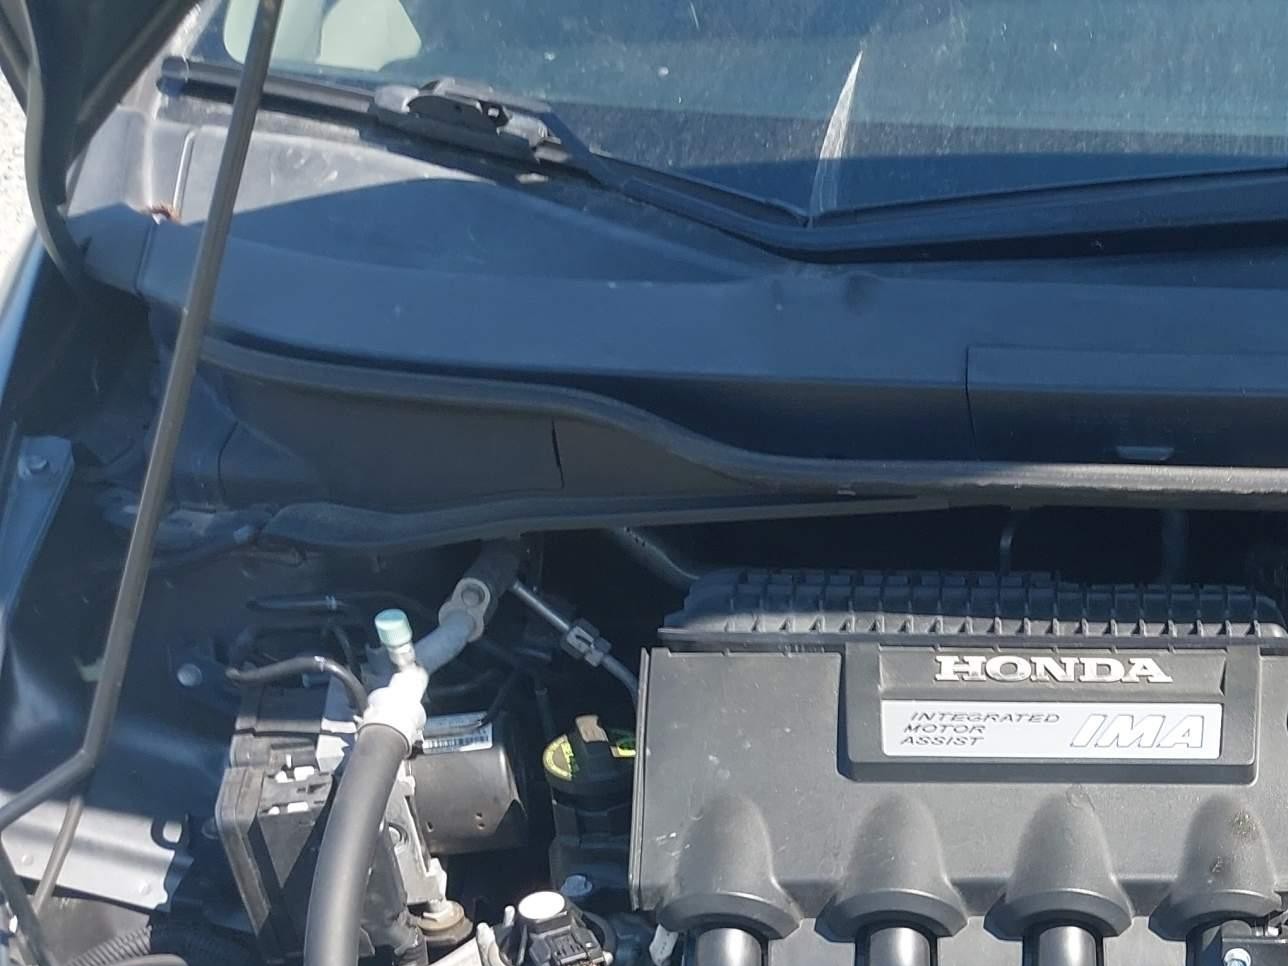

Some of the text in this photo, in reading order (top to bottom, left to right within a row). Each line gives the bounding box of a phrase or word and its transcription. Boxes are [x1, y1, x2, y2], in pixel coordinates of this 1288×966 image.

[934, 655, 1174, 684] HONDA
[909, 711, 1061, 724] INTEGRATED
[902, 724, 987, 735] MOTOR
[1069, 713, 1206, 749] IMA
[899, 736, 986, 746] ASSIST
